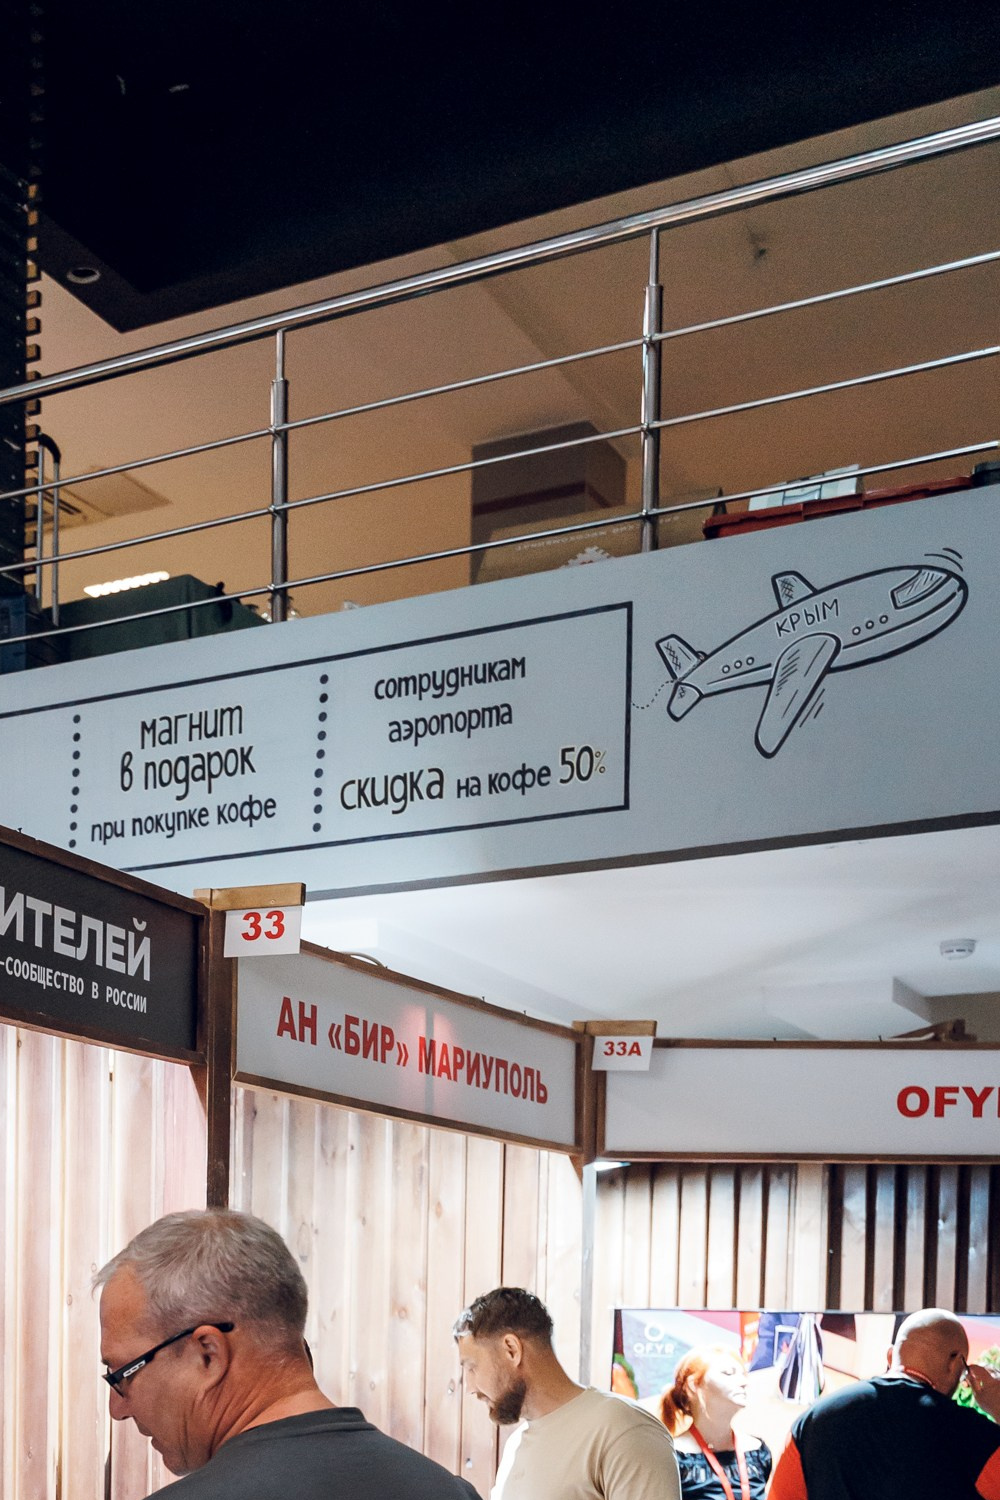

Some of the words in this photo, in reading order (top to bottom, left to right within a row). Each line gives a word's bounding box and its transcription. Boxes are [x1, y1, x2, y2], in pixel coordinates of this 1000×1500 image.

[774, 598, 841, 638] КРЫМ
[374, 656, 526, 701] сотрудникам
[141, 705, 243, 750] магнит
[388, 703, 513, 747] аэропорта
[120, 751, 133, 792] в
[144, 746, 256, 801] подарок
[340, 767, 445, 815] скидка
[457, 777, 481, 799] на
[489, 763, 551, 795] кофе
[559, 745, 606, 785] 50%
[91, 820, 125, 845] при
[132, 807, 210, 838] покупке
[217, 795, 277, 827] кофе
[241, 910, 286, 942] 33
[91, 981, 99, 1000] В
[106, 985, 147, 1014] РОССИИ
[276, 996, 318, 1046] АН
[328, 1013, 409, 1068] «БИР»
[418, 1035, 549, 1105] МАРИУПОЛЬ
[603, 1041, 642, 1057] 33А
[896, 1085, 1000, 1118] OFY
